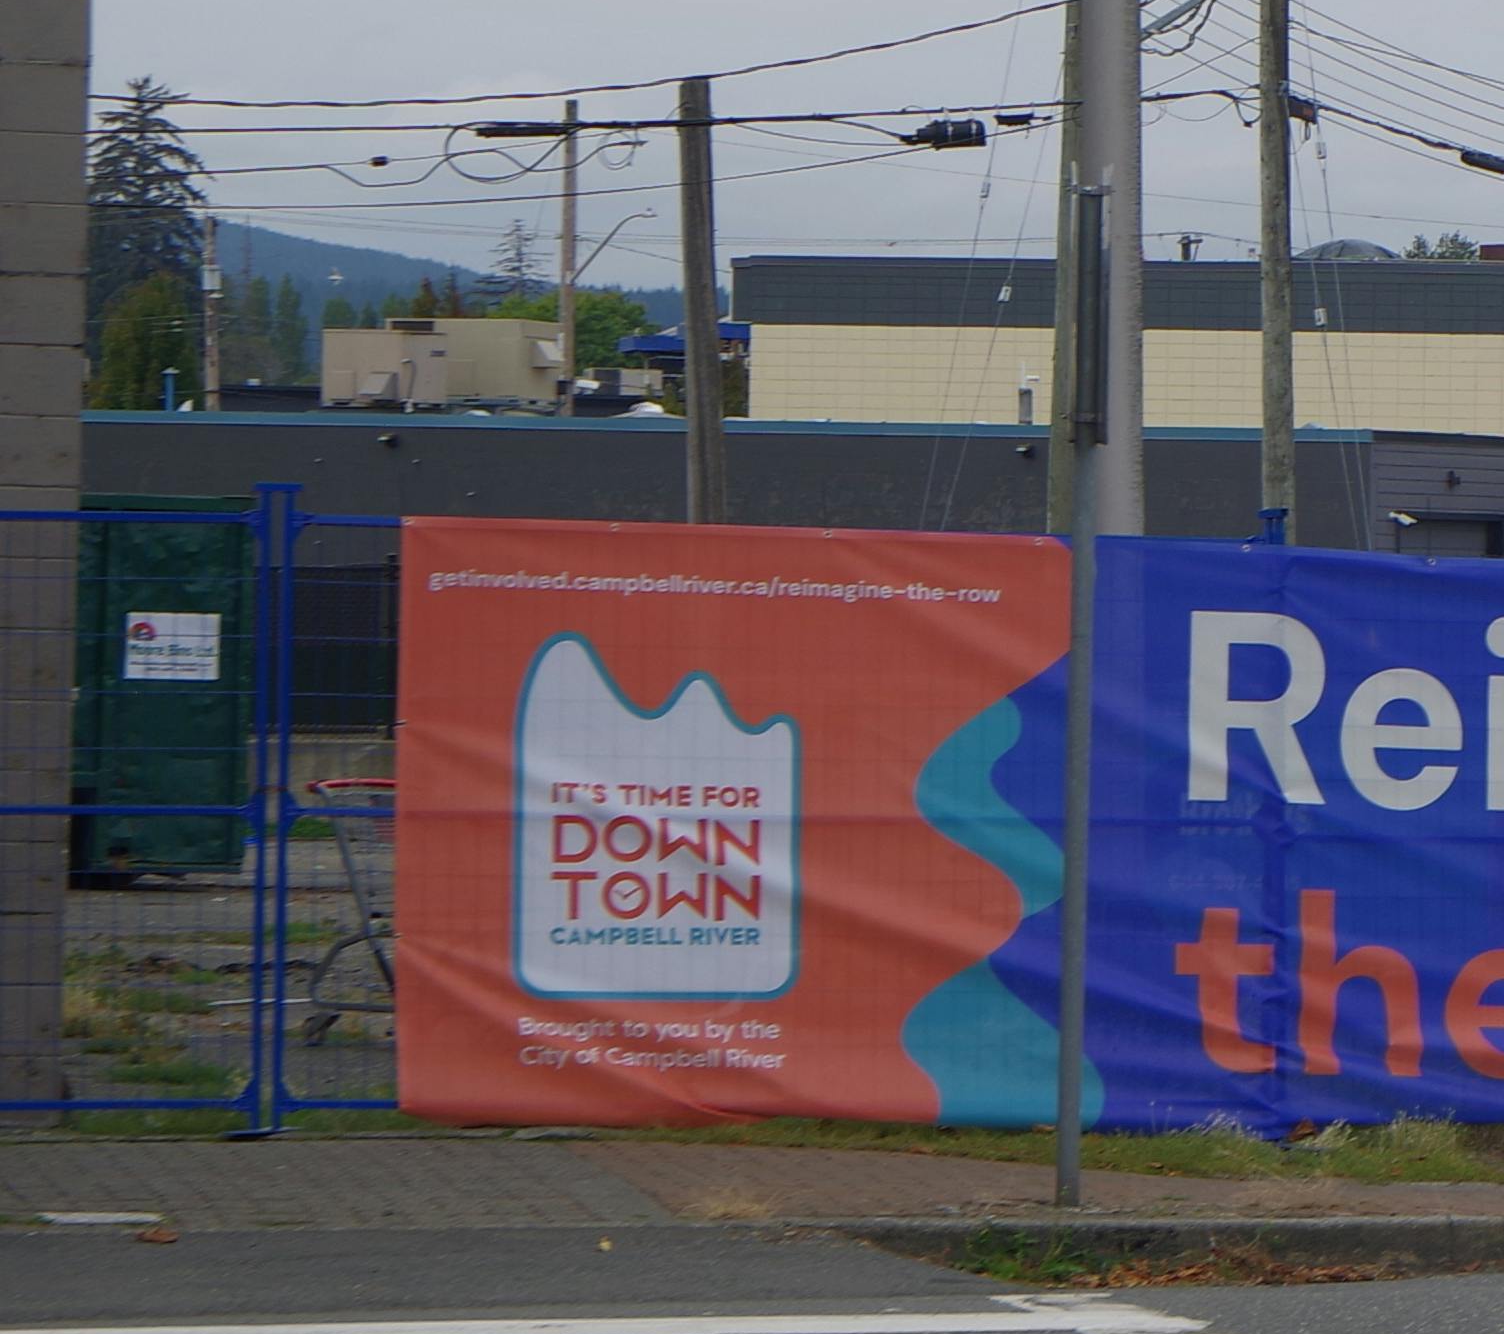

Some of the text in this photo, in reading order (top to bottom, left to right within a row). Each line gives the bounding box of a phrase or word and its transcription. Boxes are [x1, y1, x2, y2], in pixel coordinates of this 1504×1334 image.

[428, 569, 1002, 604] getinvolved.campbellriver.ca/reimagine-the-row
[551, 782, 761, 808] IT'S TIME FOR
[552, 814, 762, 866] DOWN
[550, 870, 762, 922] TOWN
[550, 926, 762, 946] CAMPBELL RIVER
[517, 1017, 782, 1043] Brought to you by the
[519, 1046, 787, 1072] City of Campbell River
